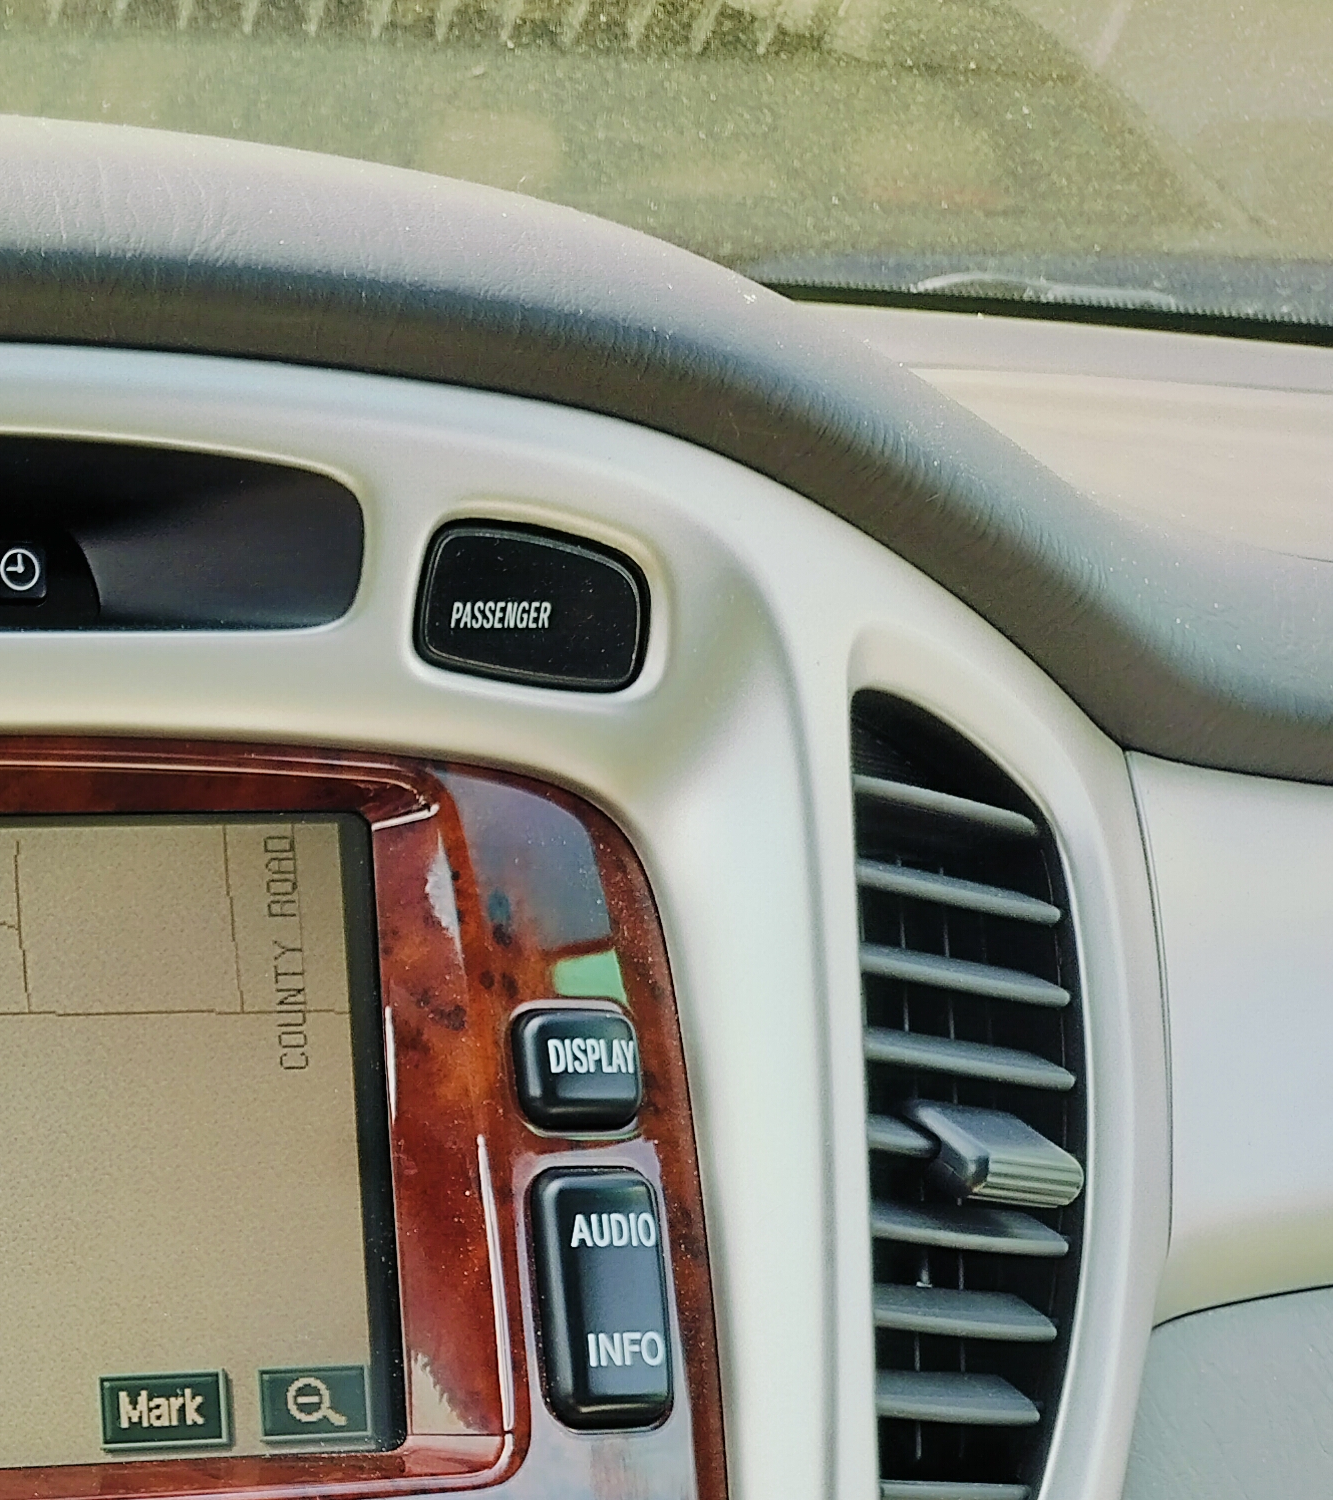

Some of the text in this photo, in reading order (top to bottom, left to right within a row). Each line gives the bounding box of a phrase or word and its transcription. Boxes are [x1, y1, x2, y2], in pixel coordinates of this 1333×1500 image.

[449, 600, 552, 630] PASSENGER
[264, 834, 310, 1071] COUNTY ROAD
[547, 1037, 635, 1075] DISPLAY
[570, 1212, 657, 1249] AUDIO
[587, 1331, 665, 1368] INFO
[117, 1387, 205, 1429] Mark
